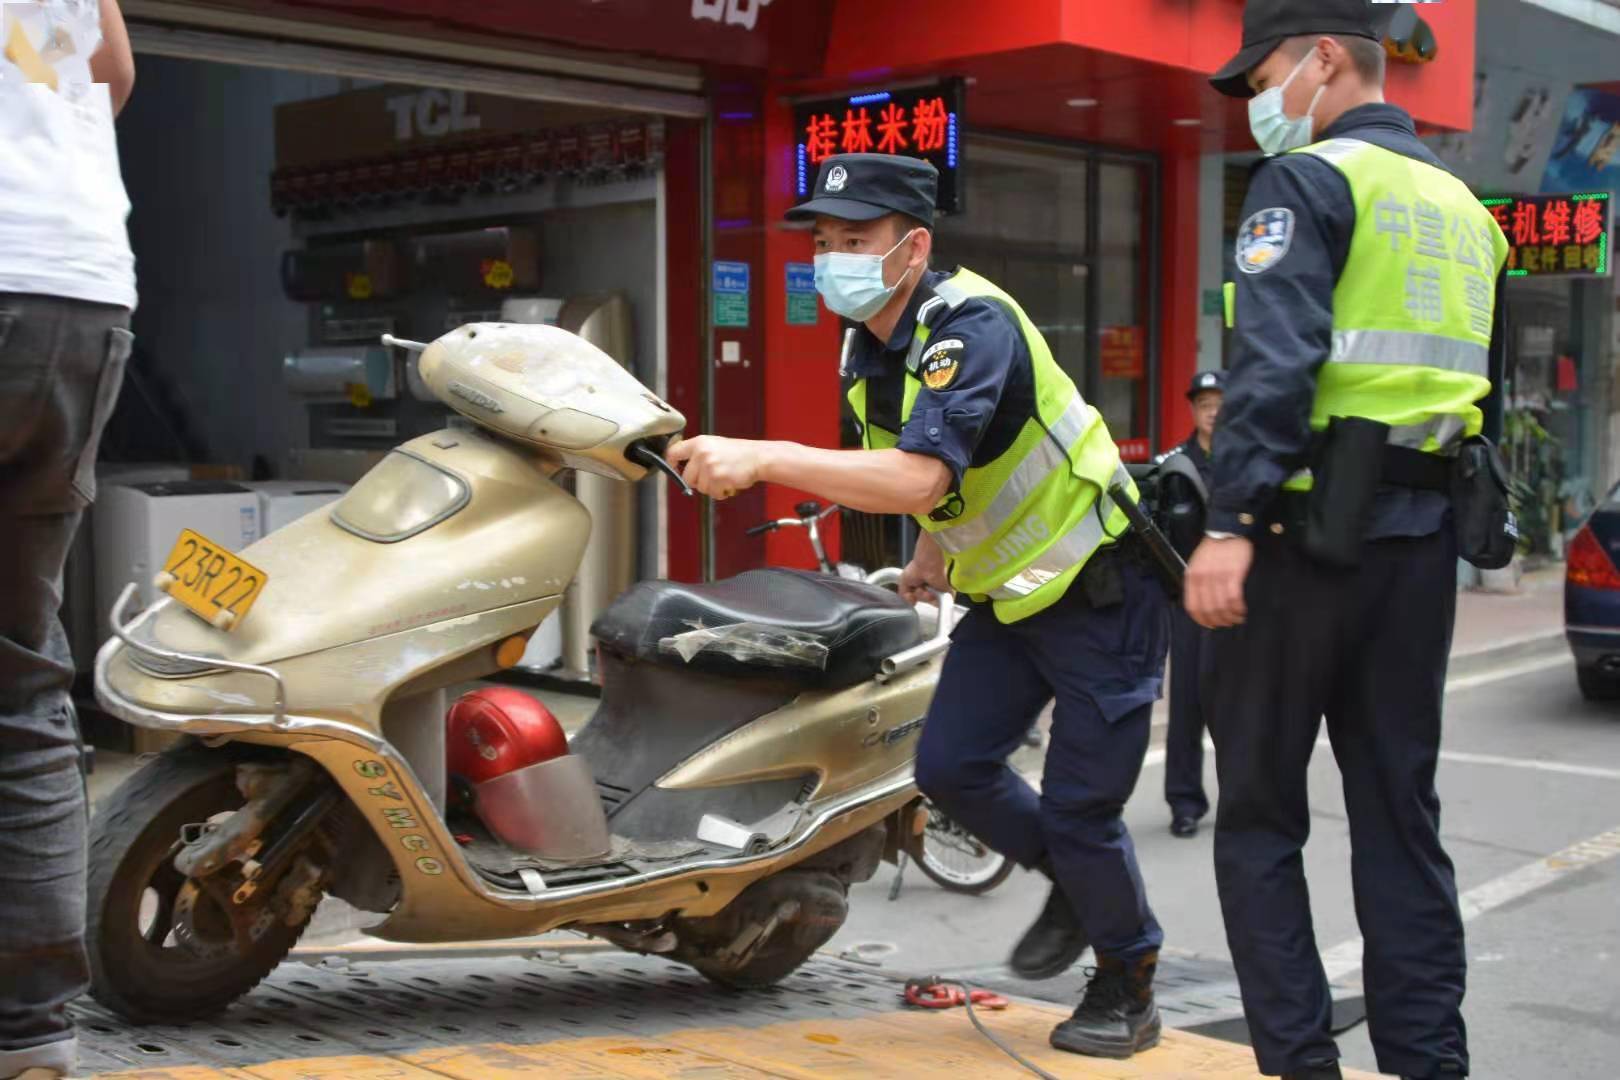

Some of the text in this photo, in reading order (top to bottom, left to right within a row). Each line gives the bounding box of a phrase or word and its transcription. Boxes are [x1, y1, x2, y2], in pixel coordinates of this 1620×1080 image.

[385, 89, 481, 139] TCL
[806, 97, 948, 163] 桂林米粉
[167, 538, 258, 617] 23R22
